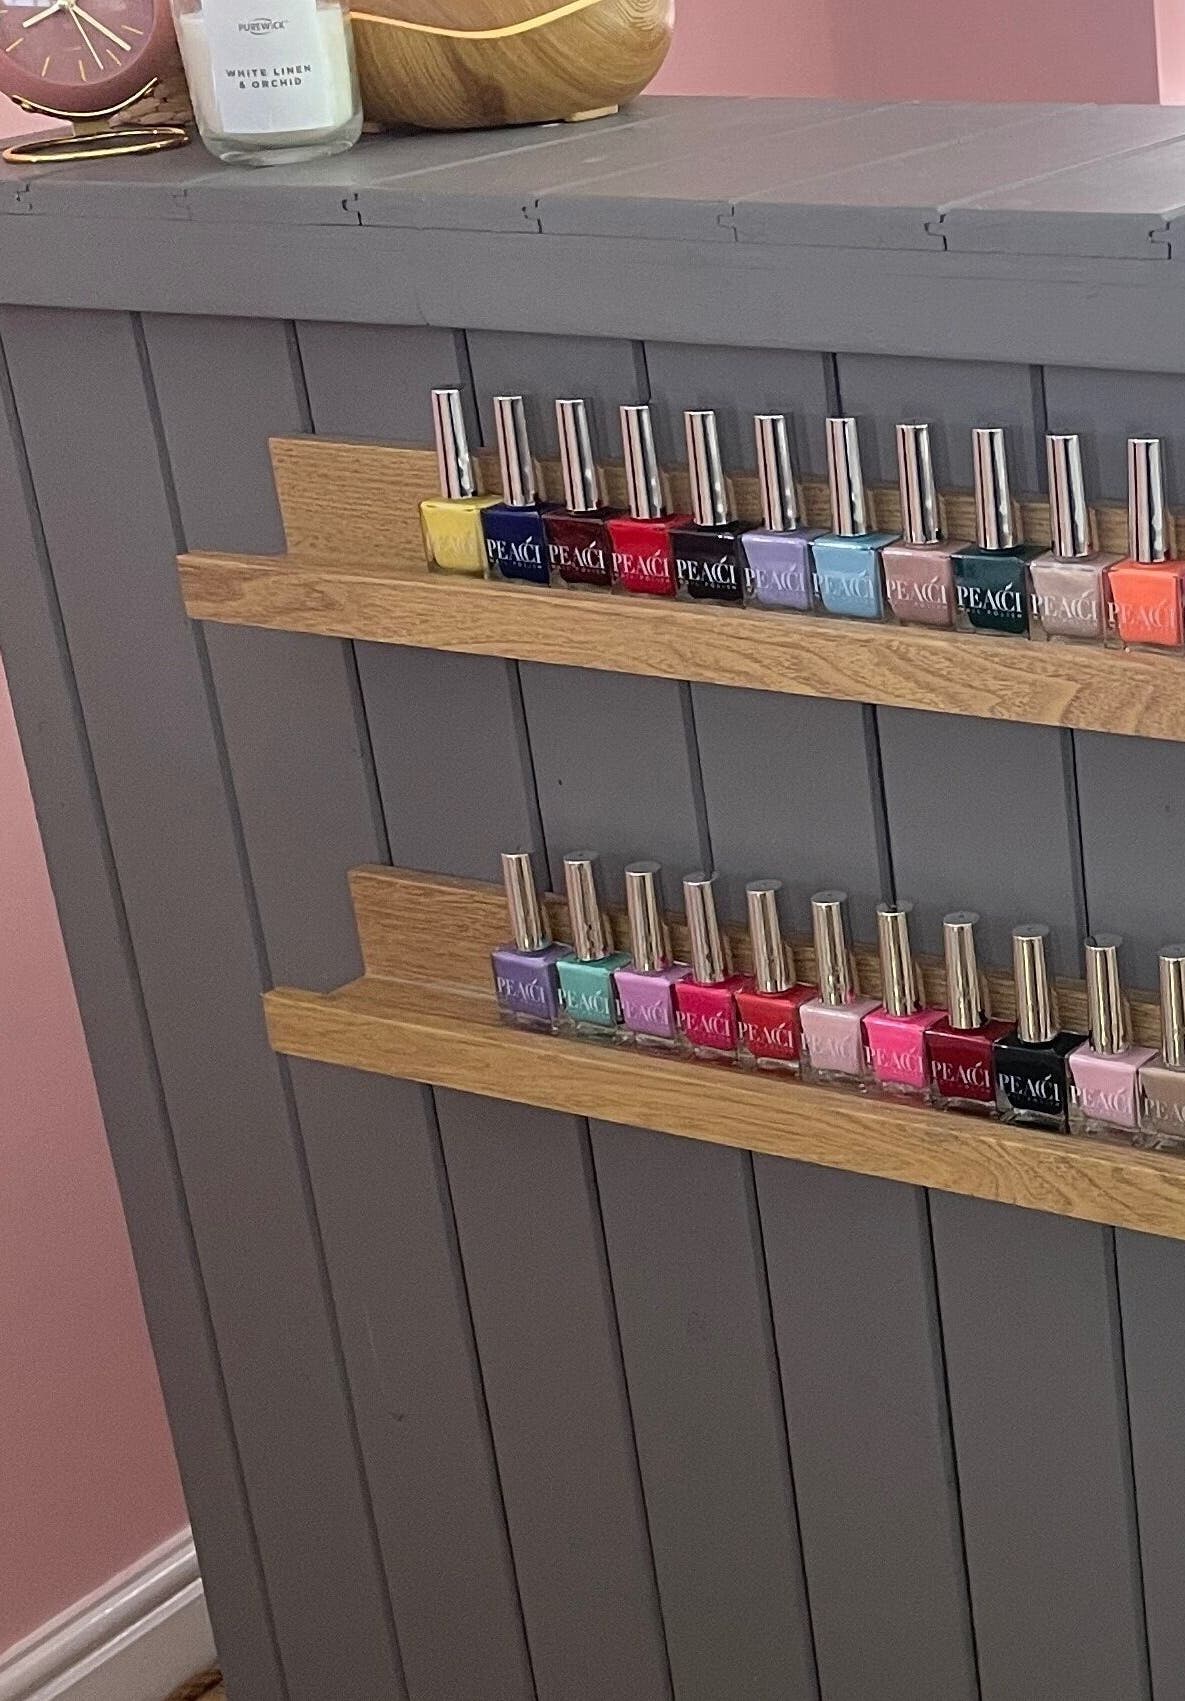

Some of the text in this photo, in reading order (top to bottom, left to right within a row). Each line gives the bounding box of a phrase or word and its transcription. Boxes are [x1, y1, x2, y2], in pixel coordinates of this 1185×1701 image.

[226, 64, 312, 78] WHITE LINEN
[239, 77, 302, 89] & ORCHID
